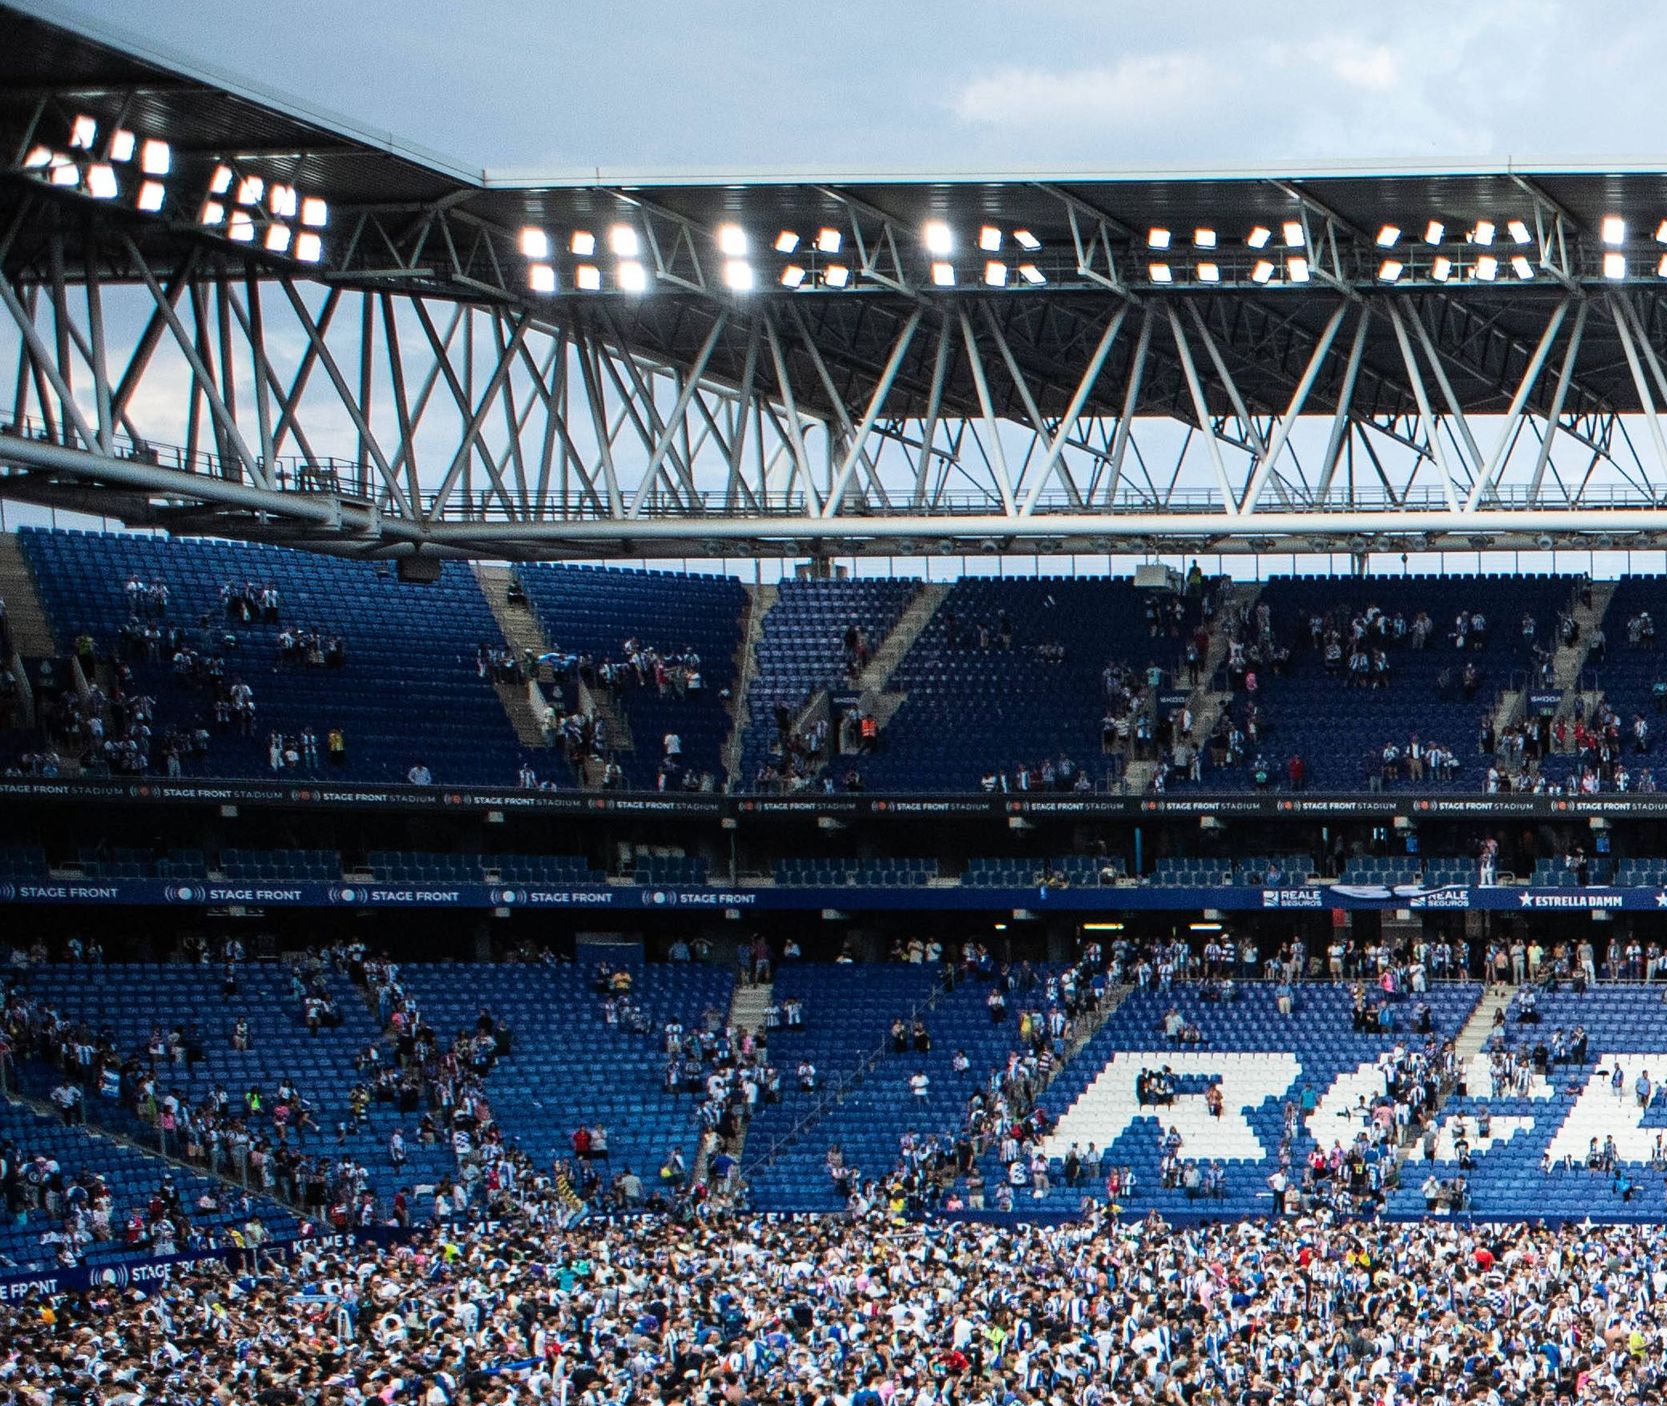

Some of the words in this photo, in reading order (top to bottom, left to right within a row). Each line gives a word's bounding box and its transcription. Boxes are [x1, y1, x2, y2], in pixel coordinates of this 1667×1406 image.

[20, 887, 66, 897] STAGE
[70, 888, 118, 897] FRONT
[210, 890, 253, 899] STAGE
[256, 891, 301, 899] FRONT
[372, 892, 412, 900] STAGE
[416, 892, 459, 901] FRONT
[1281, 891, 1320, 899] REALE
[531, 893, 569, 902] STAGE
[572, 893, 612, 902] FRONT
[680, 894, 716, 903] STAGE
[719, 894, 755, 903] FRONT
[1536, 896, 1586, 906] ESTRELLA
[1586, 896, 1622, 906] DAMM
